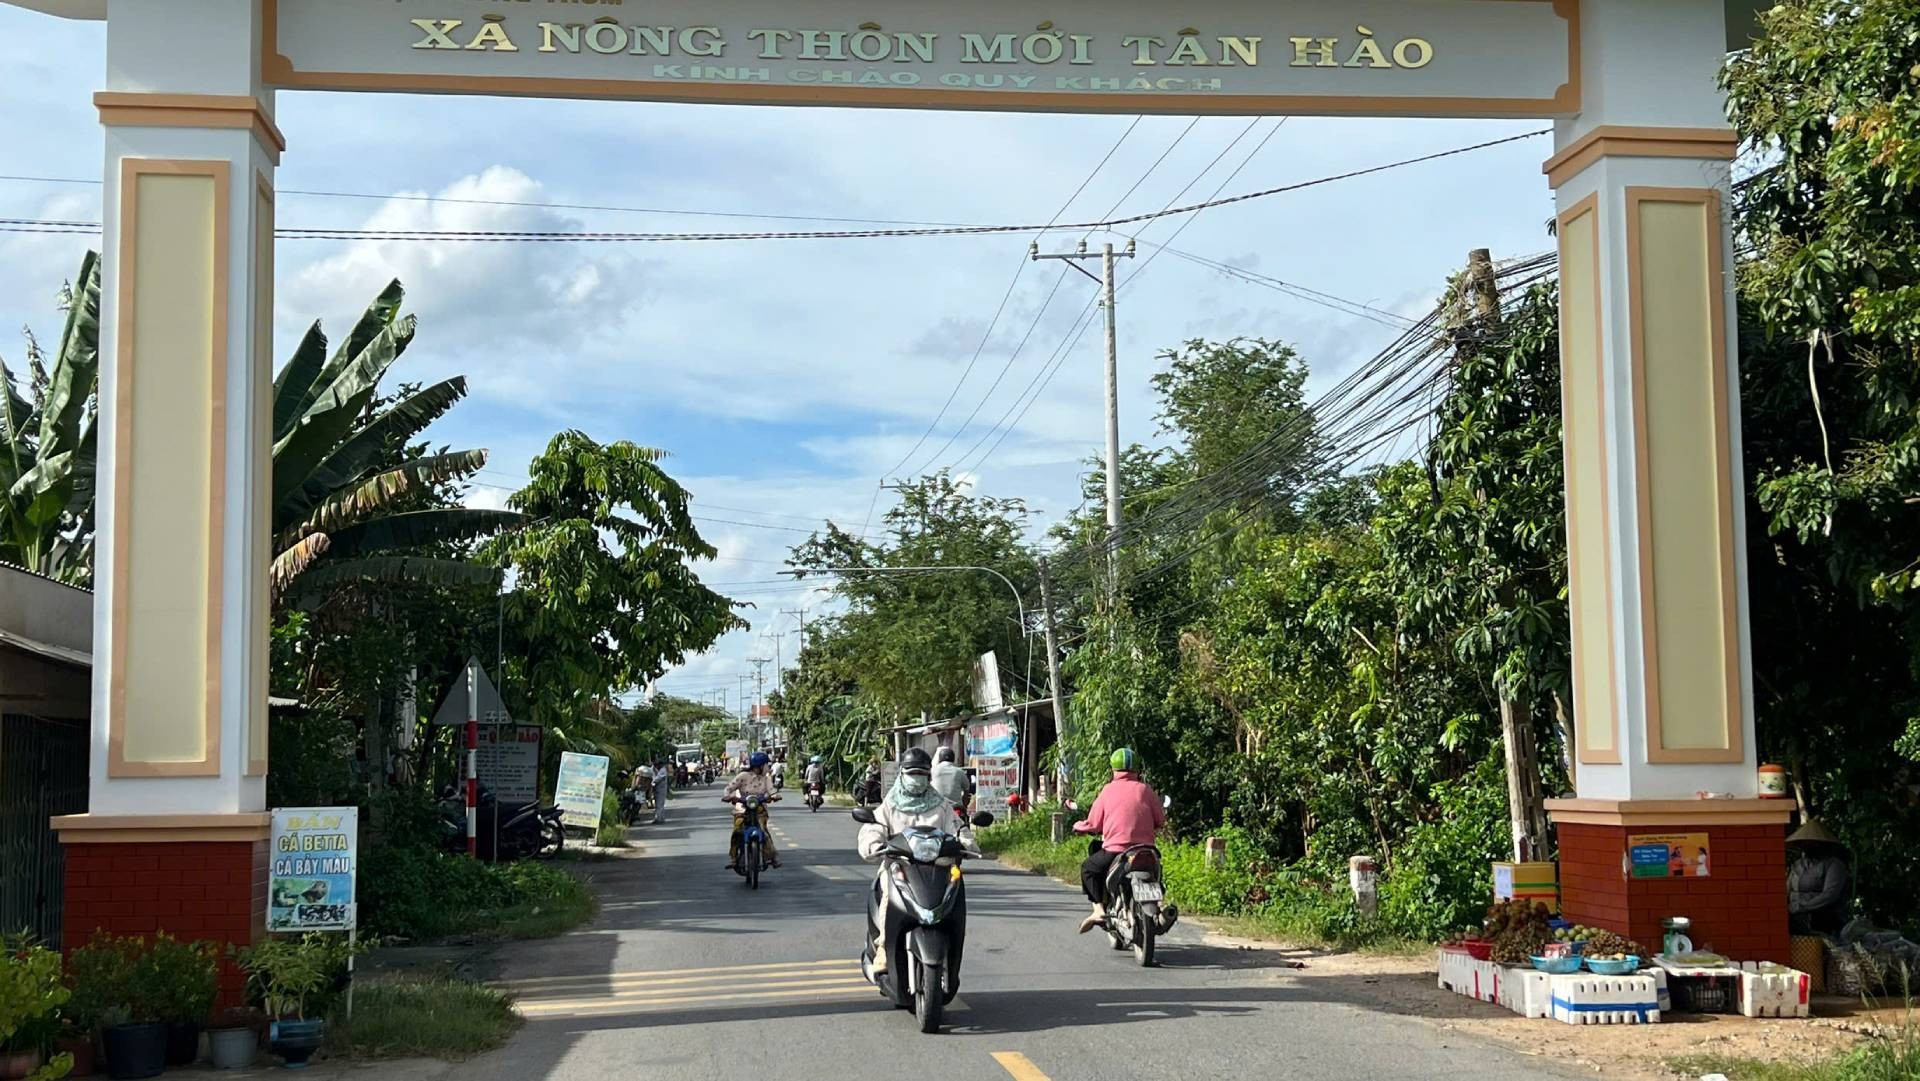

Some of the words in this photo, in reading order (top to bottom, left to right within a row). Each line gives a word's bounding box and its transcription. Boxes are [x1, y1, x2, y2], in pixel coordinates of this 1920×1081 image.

[410, 14, 518, 51] XÃ
[538, 16, 726, 57] NÔNG
[747, 22, 938, 62] THÔN
[960, 20, 1094, 64] MỚI
[1121, 27, 1262, 66] TÂN
[1289, 24, 1433, 68] HÀO
[652, 60, 770, 81] KÍNH
[1055, 72, 1221, 91] KHÁCH
[278, 832, 299, 852] CÁ
[303, 833, 348, 852] BETTA
[275, 856, 293, 876] CÁ
[322, 854, 350, 874] MÀU
